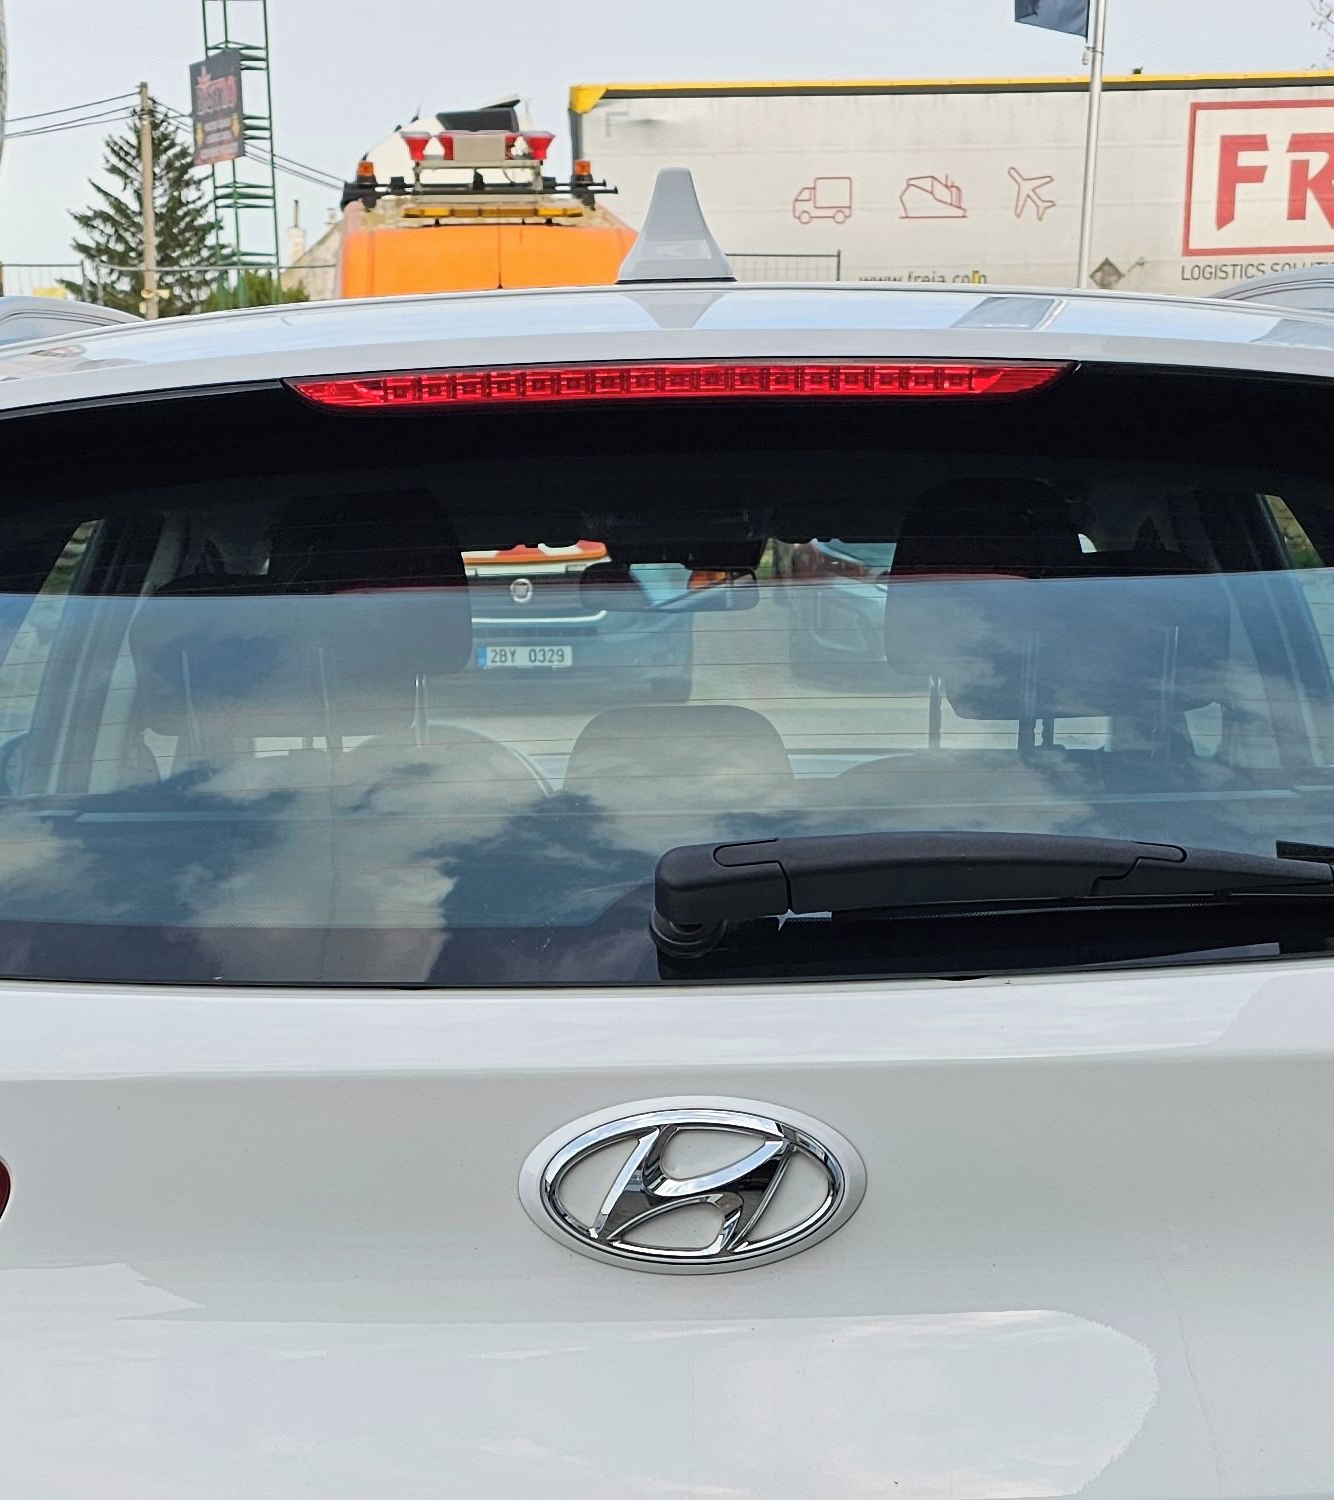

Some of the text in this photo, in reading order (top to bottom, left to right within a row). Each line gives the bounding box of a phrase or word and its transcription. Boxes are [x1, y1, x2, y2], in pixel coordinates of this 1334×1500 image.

[1181, 263, 1266, 280] LOGISTICS
[490, 648, 565, 663] 2BY 0329
